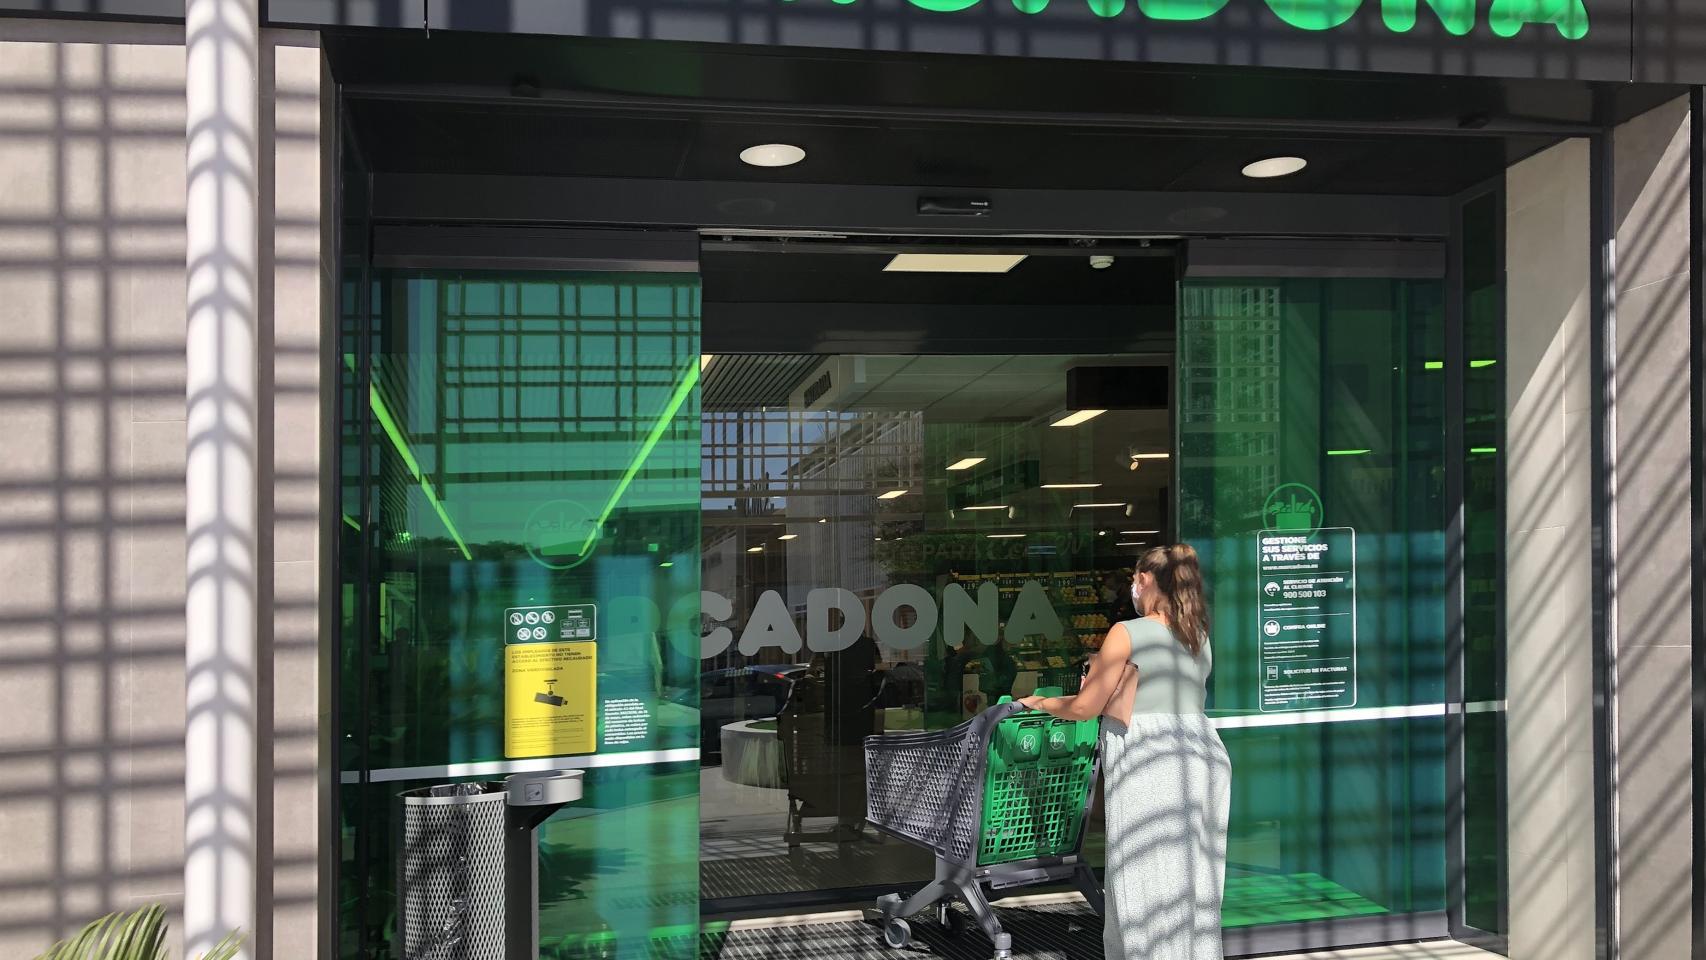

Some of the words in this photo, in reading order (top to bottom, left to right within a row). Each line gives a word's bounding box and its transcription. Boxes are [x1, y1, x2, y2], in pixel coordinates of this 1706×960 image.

[1262, 536, 1307, 544] GESTIONE
[1281, 544, 1328, 553] SERVICIOS
[1262, 554, 1270, 562] A
[1271, 552, 1306, 561] TRAVÉS
[1307, 552, 1320, 560] DE
[1283, 591, 1297, 599] 900
[1298, 590, 1312, 598] 500
[1313, 589, 1326, 597] 103
